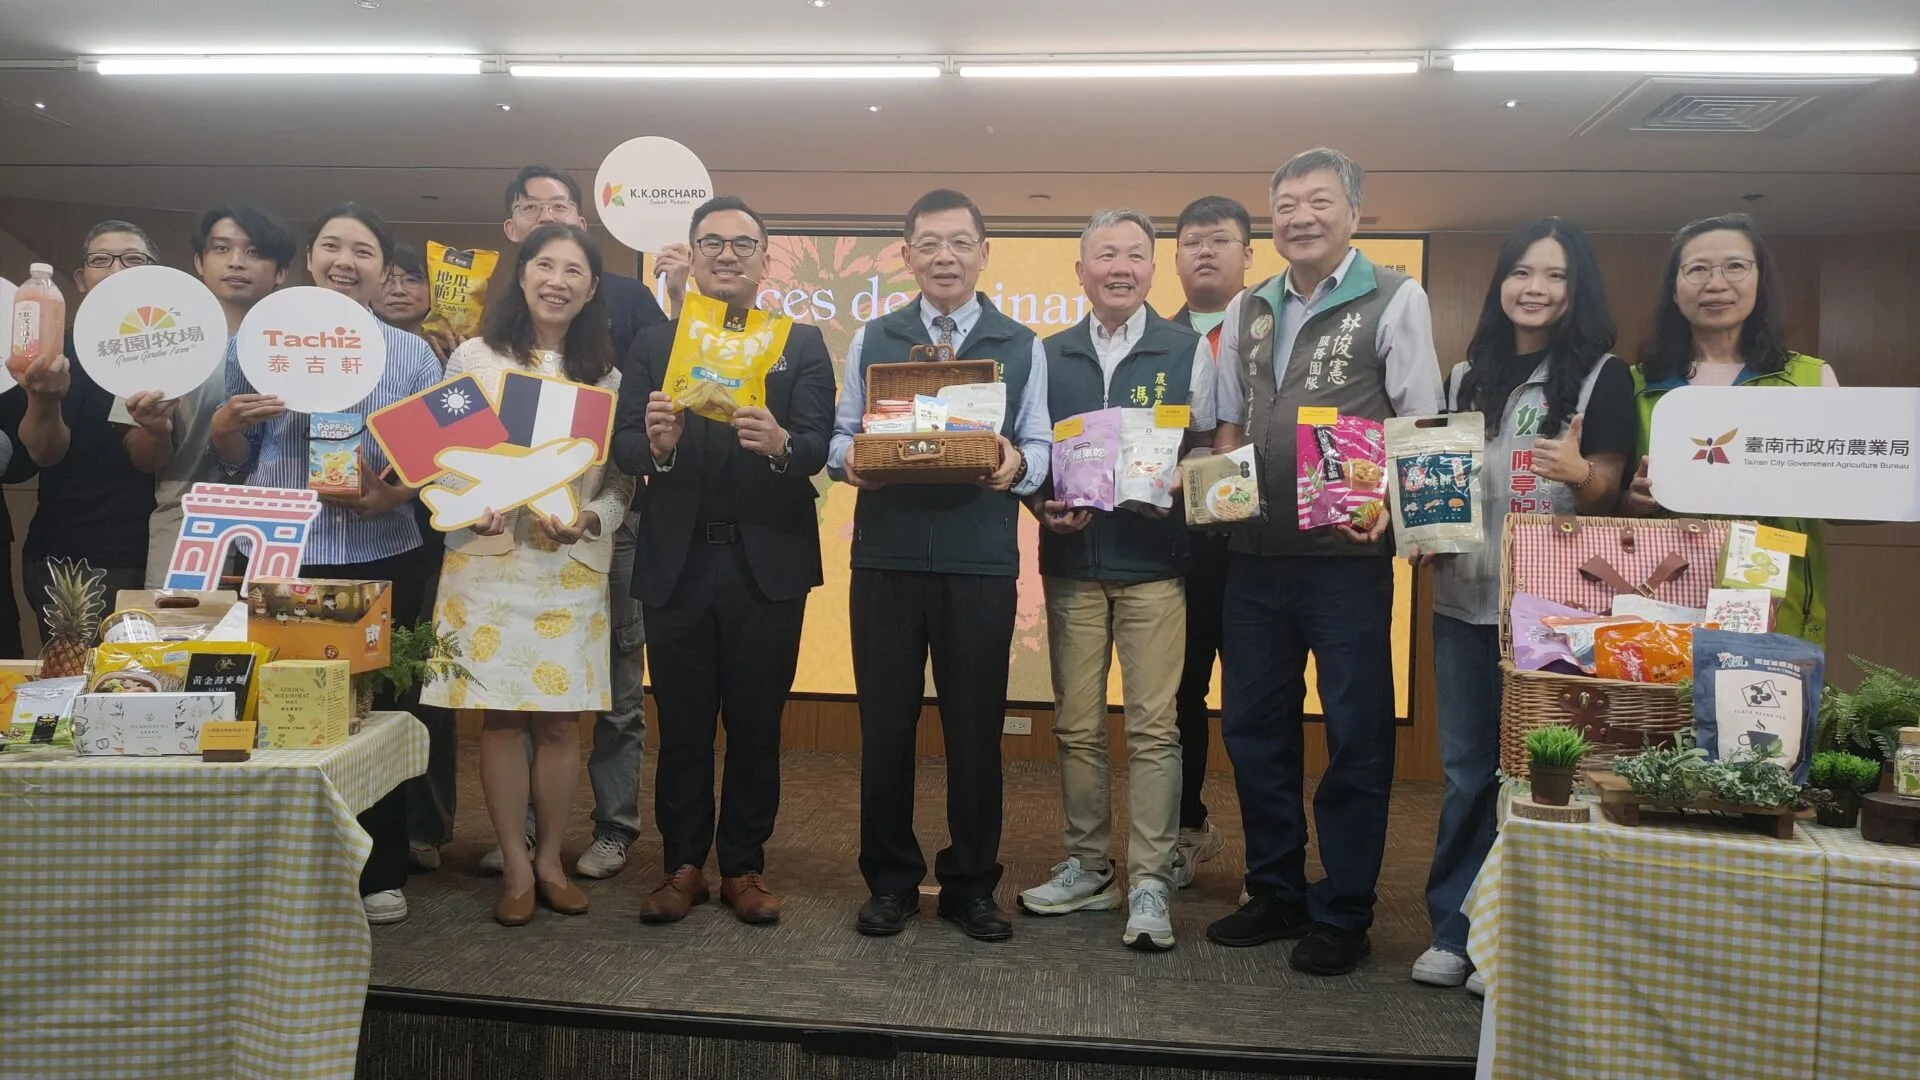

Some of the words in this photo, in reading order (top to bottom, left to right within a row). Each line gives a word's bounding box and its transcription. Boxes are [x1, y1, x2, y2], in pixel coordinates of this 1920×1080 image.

[630, 188, 707, 199] K.K.ORCHARD
[435, 270, 469, 288] 地瓜
[435, 284, 466, 303] 脆片
[97, 325, 205, 358] 綠園牧場
[262, 326, 362, 349] Tachiz
[115, 351, 139, 366] Green
[140, 350, 167, 364] Garden
[168, 346, 191, 357] Farm
[1327, 312, 1364, 386] 林俊憲
[268, 354, 363, 375] 泰吉軒
[1304, 335, 1331, 390] 服務團隊
[1130, 385, 1149, 406] 馮
[1745, 436, 1910, 457] 臺南市政府農業局
[1743, 458, 1768, 466] Tainan
[1770, 459, 1786, 468] City
[1787, 459, 1835, 469] Government
[1835, 461, 1878, 470] Agriculture
